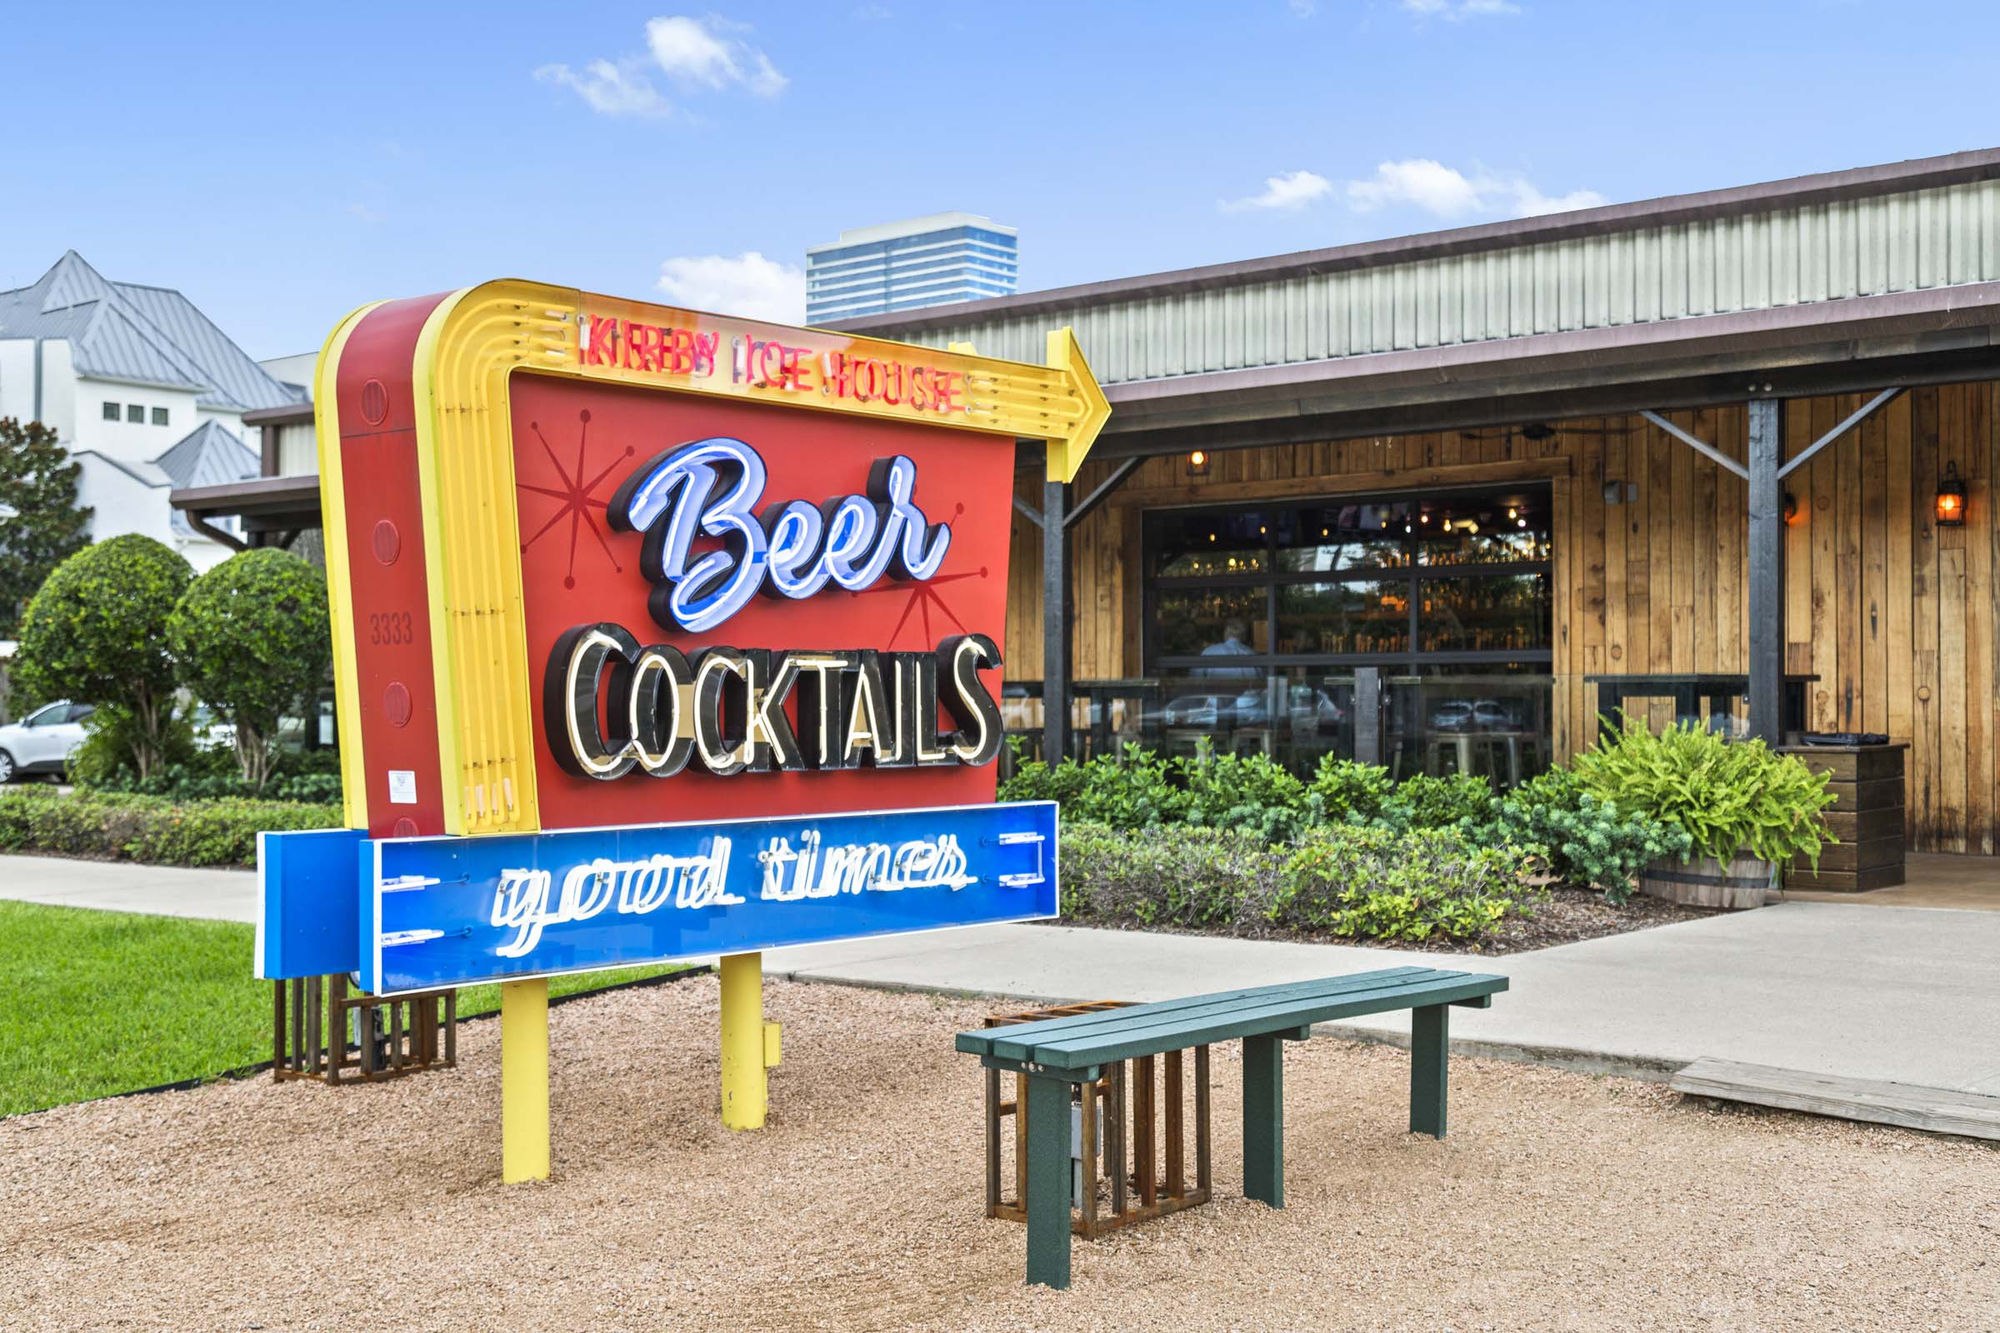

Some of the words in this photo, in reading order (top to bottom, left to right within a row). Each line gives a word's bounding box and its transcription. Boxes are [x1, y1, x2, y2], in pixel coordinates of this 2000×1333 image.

[583, 313, 720, 377] KIRBY
[743, 333, 815, 391] ICE
[828, 351, 965, 413] HOUSE
[608, 437, 952, 633] Beer
[370, 611, 414, 645] 3333
[544, 623, 1003, 781] COCKTAILS
[490, 836, 745, 958] good
[757, 829, 978, 902] times
